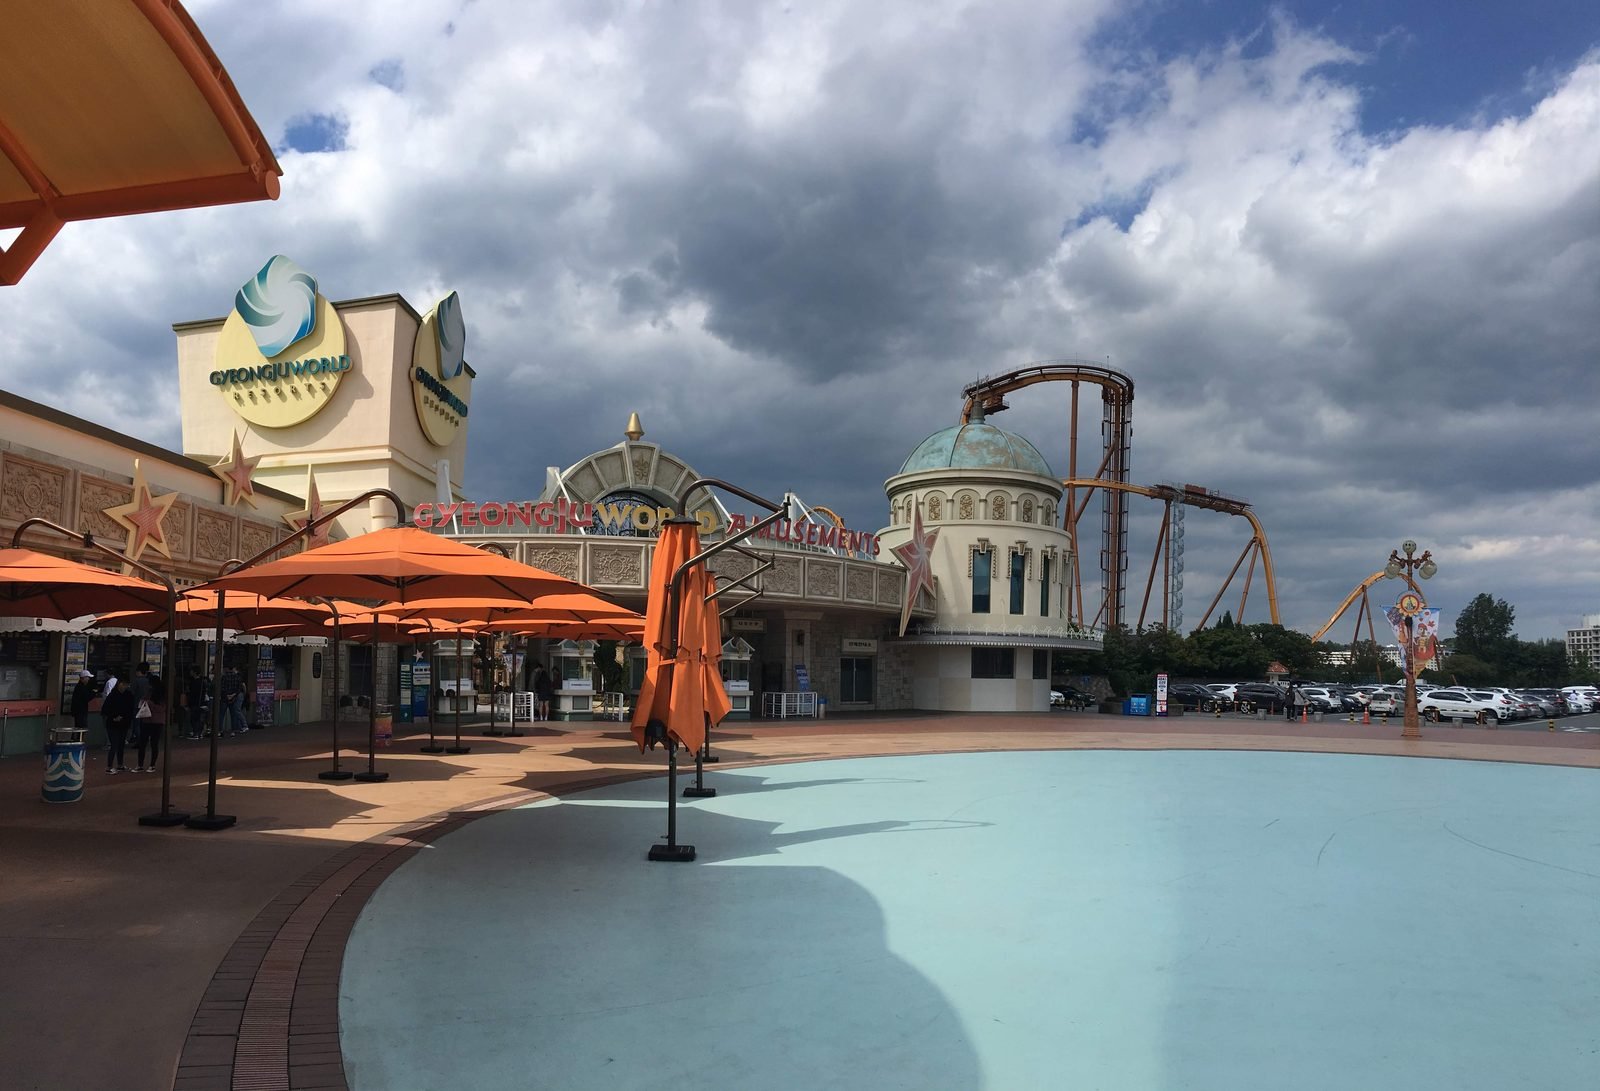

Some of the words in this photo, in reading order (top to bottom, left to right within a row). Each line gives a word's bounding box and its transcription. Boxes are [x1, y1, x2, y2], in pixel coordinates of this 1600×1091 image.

[412, 496, 594, 534] GYEONGJU
[596, 501, 718, 535] WORD
[726, 512, 881, 556] AMUSEMENTS
